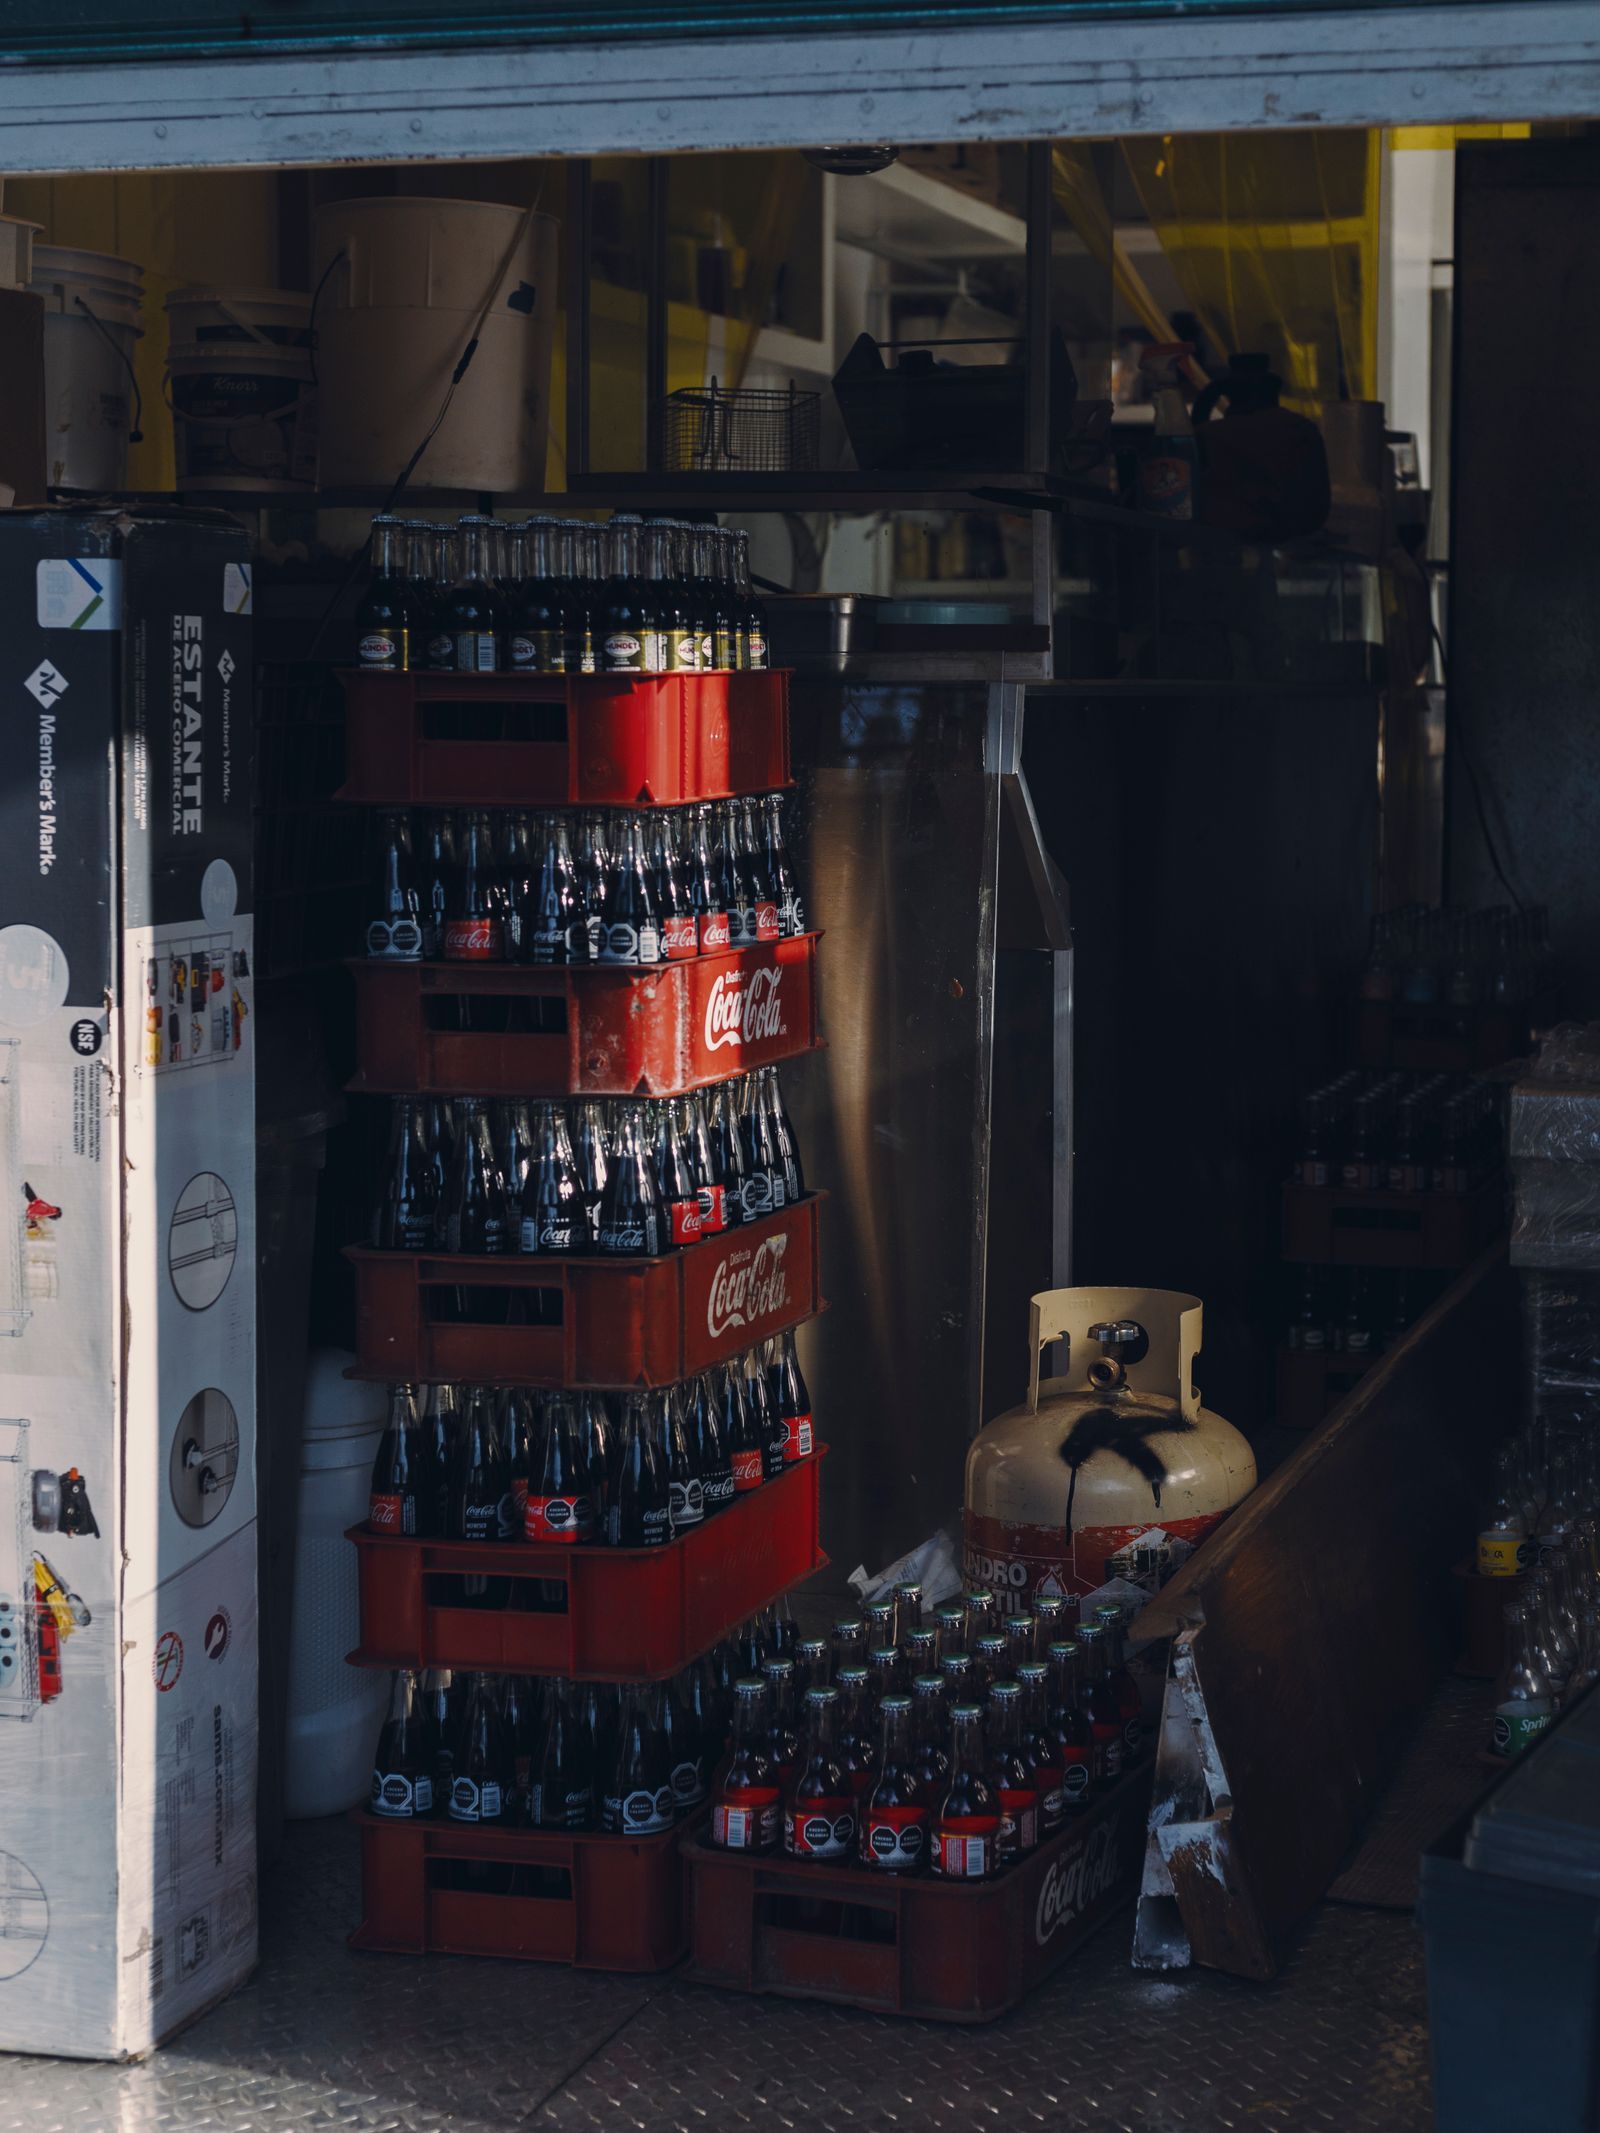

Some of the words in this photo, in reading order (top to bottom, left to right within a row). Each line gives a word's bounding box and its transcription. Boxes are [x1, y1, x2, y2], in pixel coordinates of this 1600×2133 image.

[212, 377, 260, 393] Knorr
[172, 615, 182, 642] DE
[172, 646, 182, 714] ACERO
[183, 615, 203, 835] ESTANTE
[221, 688, 232, 758] Member's
[39, 714, 57, 811] Member's
[172, 718, 182, 835] COMERCIAL
[78, 1023, 95, 1051] NSF
[730, 1249, 751, 1266] Disfruta
[213, 1705, 225, 1867] sams.com.mx
